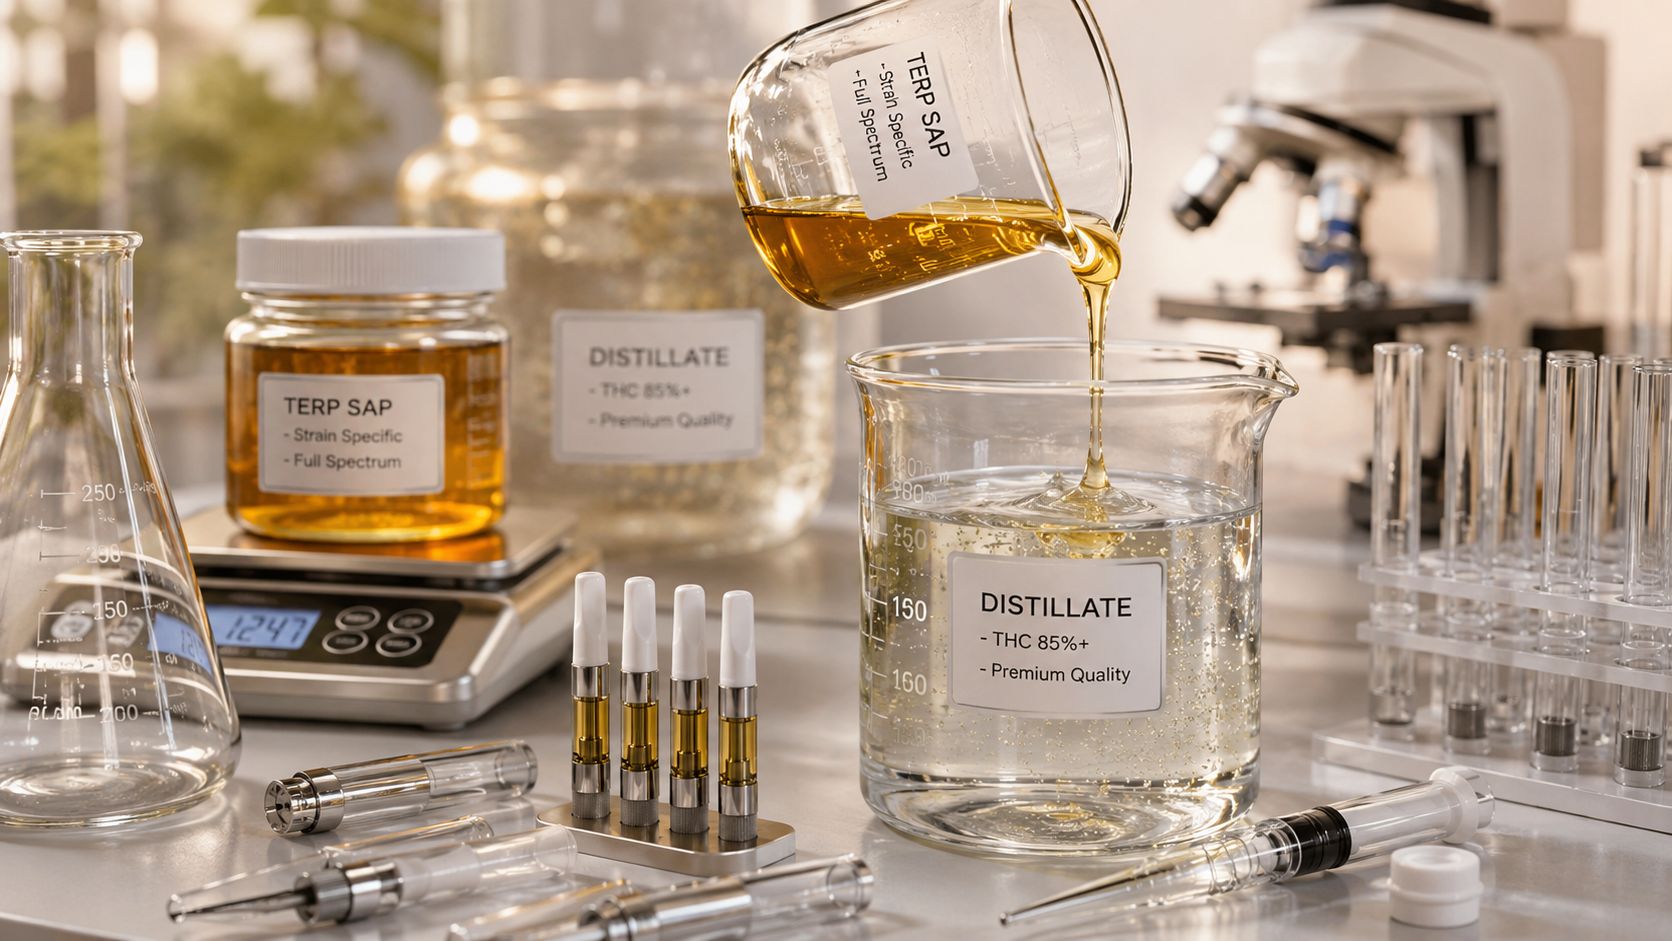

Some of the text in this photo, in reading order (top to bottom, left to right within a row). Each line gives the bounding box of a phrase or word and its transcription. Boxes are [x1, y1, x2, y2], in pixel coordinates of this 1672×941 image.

[907, 51, 951, 158] TERP SAP
[858, 108, 889, 182] Spectrum
[887, 112, 913, 169] Specific
[588, 346, 730, 368] DISTILLATE
[601, 382, 639, 398] THC
[284, 397, 393, 417] TERP SAP
[600, 412, 674, 428] Premium
[676, 412, 734, 430] Quality
[293, 427, 337, 443] Strain
[341, 428, 403, 446] Specific
[294, 453, 321, 468] Full
[326, 454, 402, 472] Spectrum
[81, 483, 116, 502] 250
[981, 592, 1132, 618] DISTILLATE
[225, 615, 308, 643] 1247
[992, 631, 1032, 649] THC
[1037, 634, 1089, 651] 85%+
[892, 668, 927, 696] 160
[991, 662, 1065, 682] Premium
[1070, 666, 1131, 685] Quality
